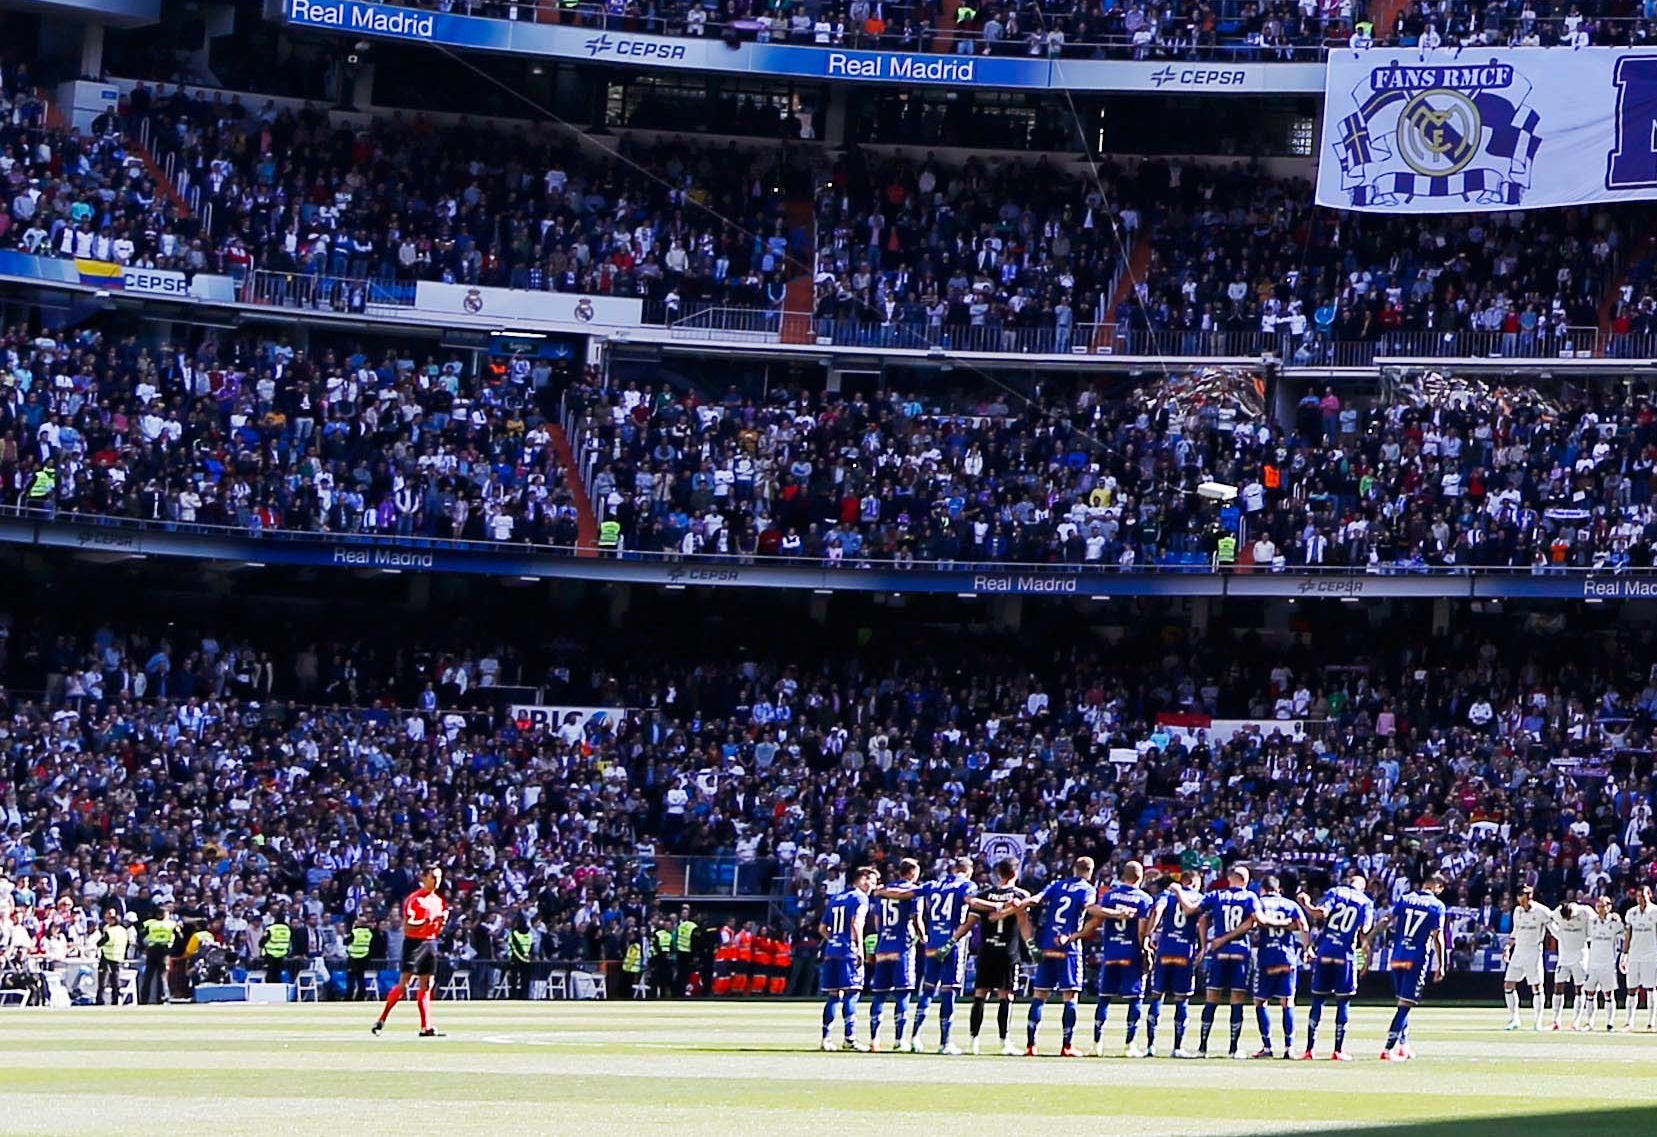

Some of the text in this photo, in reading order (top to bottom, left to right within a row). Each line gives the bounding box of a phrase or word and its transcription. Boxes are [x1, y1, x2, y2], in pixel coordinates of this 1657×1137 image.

[351, 7, 434, 38] Madrid
[616, 40, 686, 61] CEPSA
[829, 53, 974, 82] Real Madrid
[1181, 69, 1246, 86] CEPSA
[1375, 66, 1510, 89] FANS RMCF
[124, 273, 188, 293] CEPSA
[334, 548, 433, 567] Real Madrid
[974, 575, 1076, 592] Real Madrid
[1584, 580, 1619, 595] Real
[832, 906, 846, 934] 11
[881, 899, 899, 926] 15
[930, 893, 955, 921] 24
[1054, 896, 1072, 924] 2
[1221, 904, 1243, 932] 18
[1327, 903, 1358, 933] 20
[1403, 908, 1428, 937] 17
